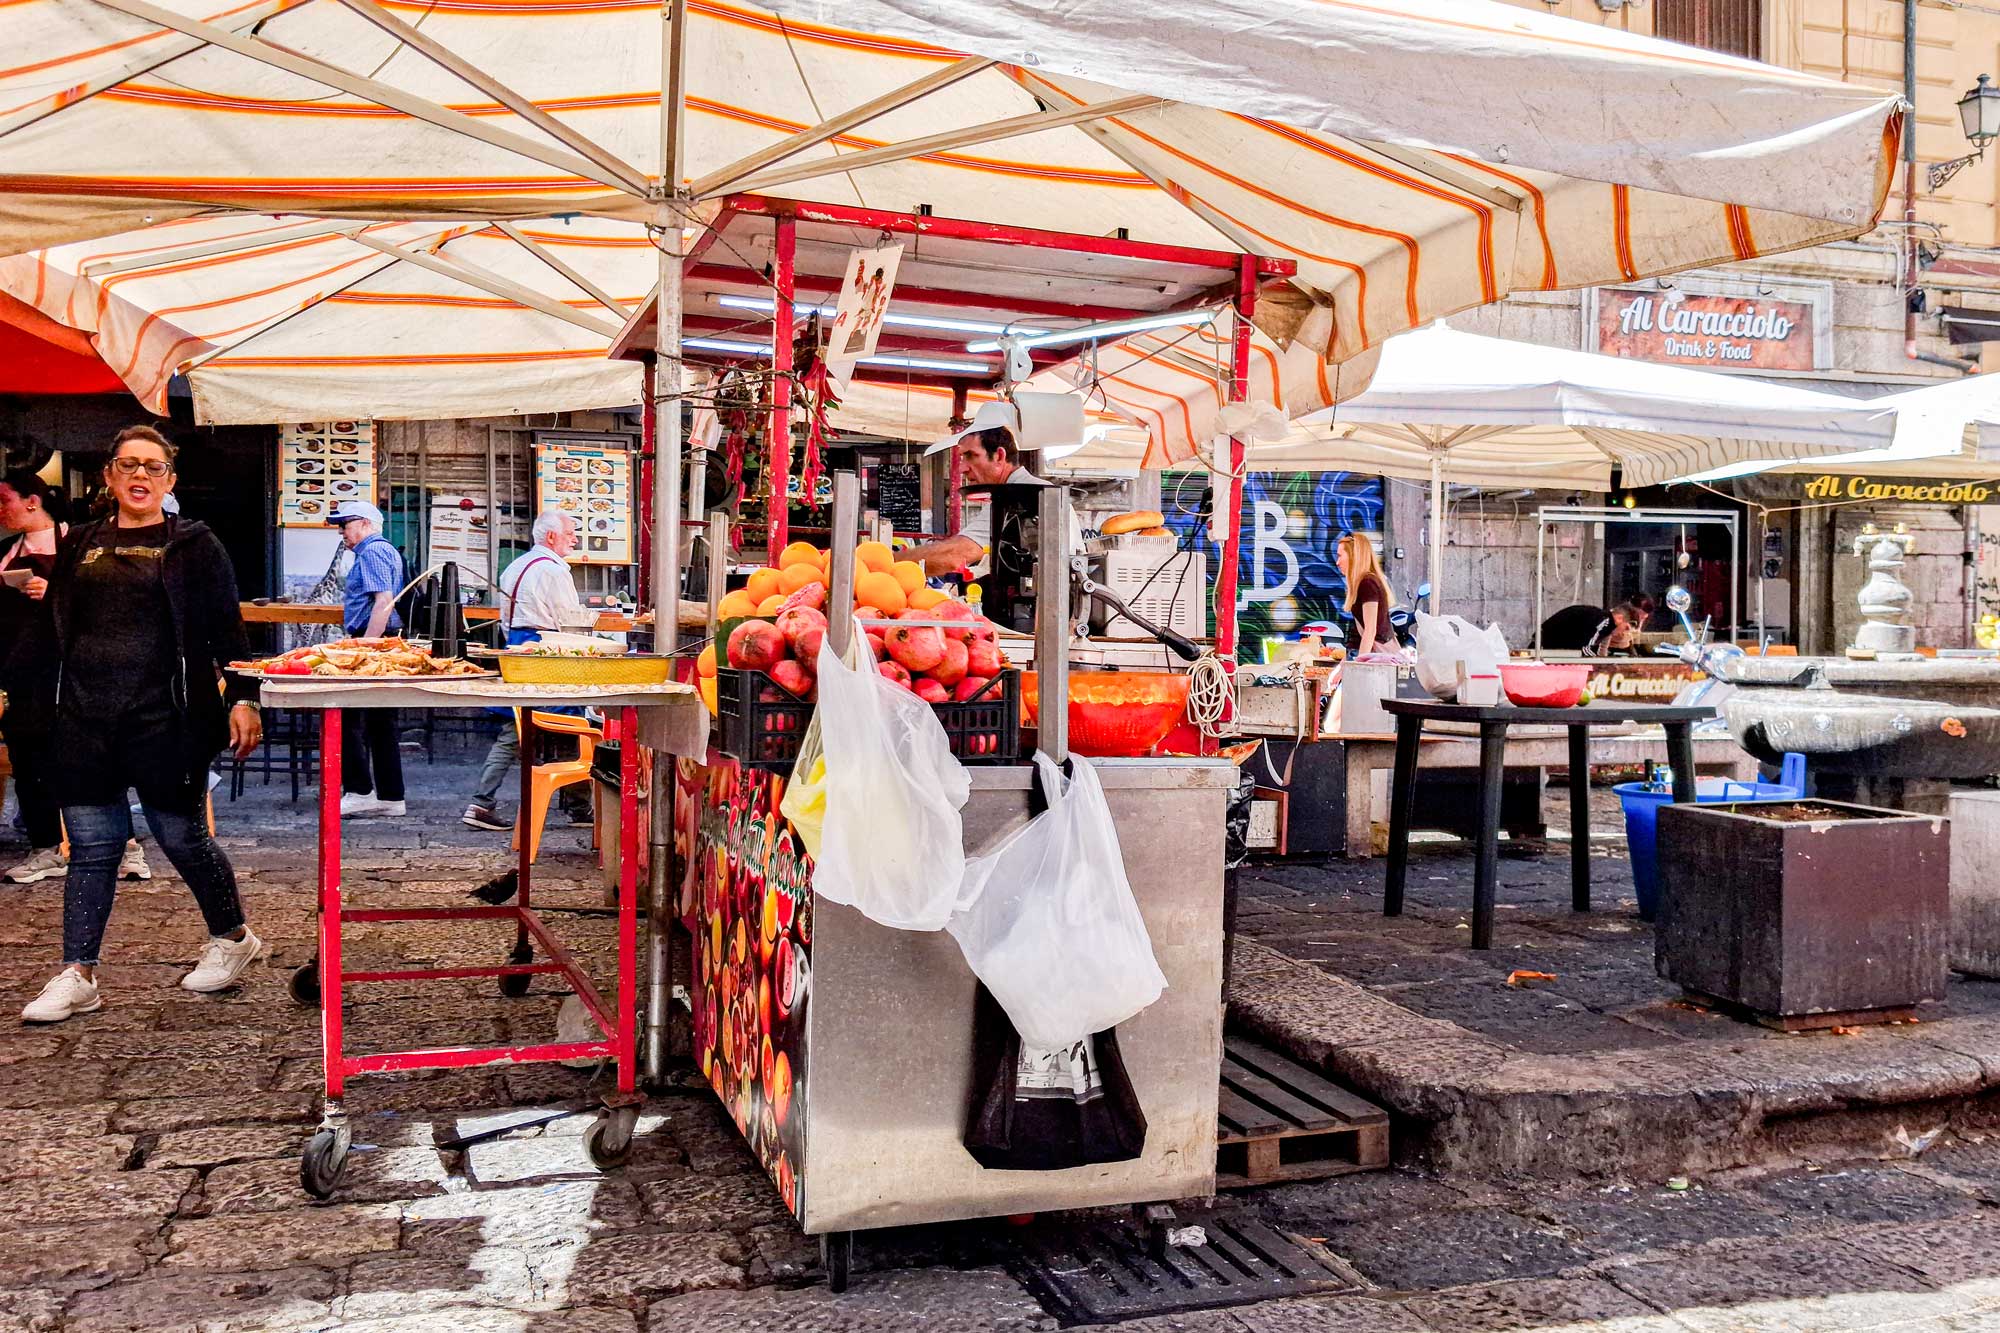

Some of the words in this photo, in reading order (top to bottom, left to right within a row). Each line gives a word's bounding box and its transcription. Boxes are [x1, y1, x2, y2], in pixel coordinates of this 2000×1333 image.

[1620, 296, 1653, 334] Al
[1658, 299, 1794, 340] Caracciolo
[1665, 337, 1703, 358] Drink
[1704, 341, 1717, 358] &
[1720, 341, 1752, 360] Food
[1805, 475, 1842, 498] Al
[1847, 476, 1992, 502] Caracciolo
[1588, 673, 1609, 698] Al
